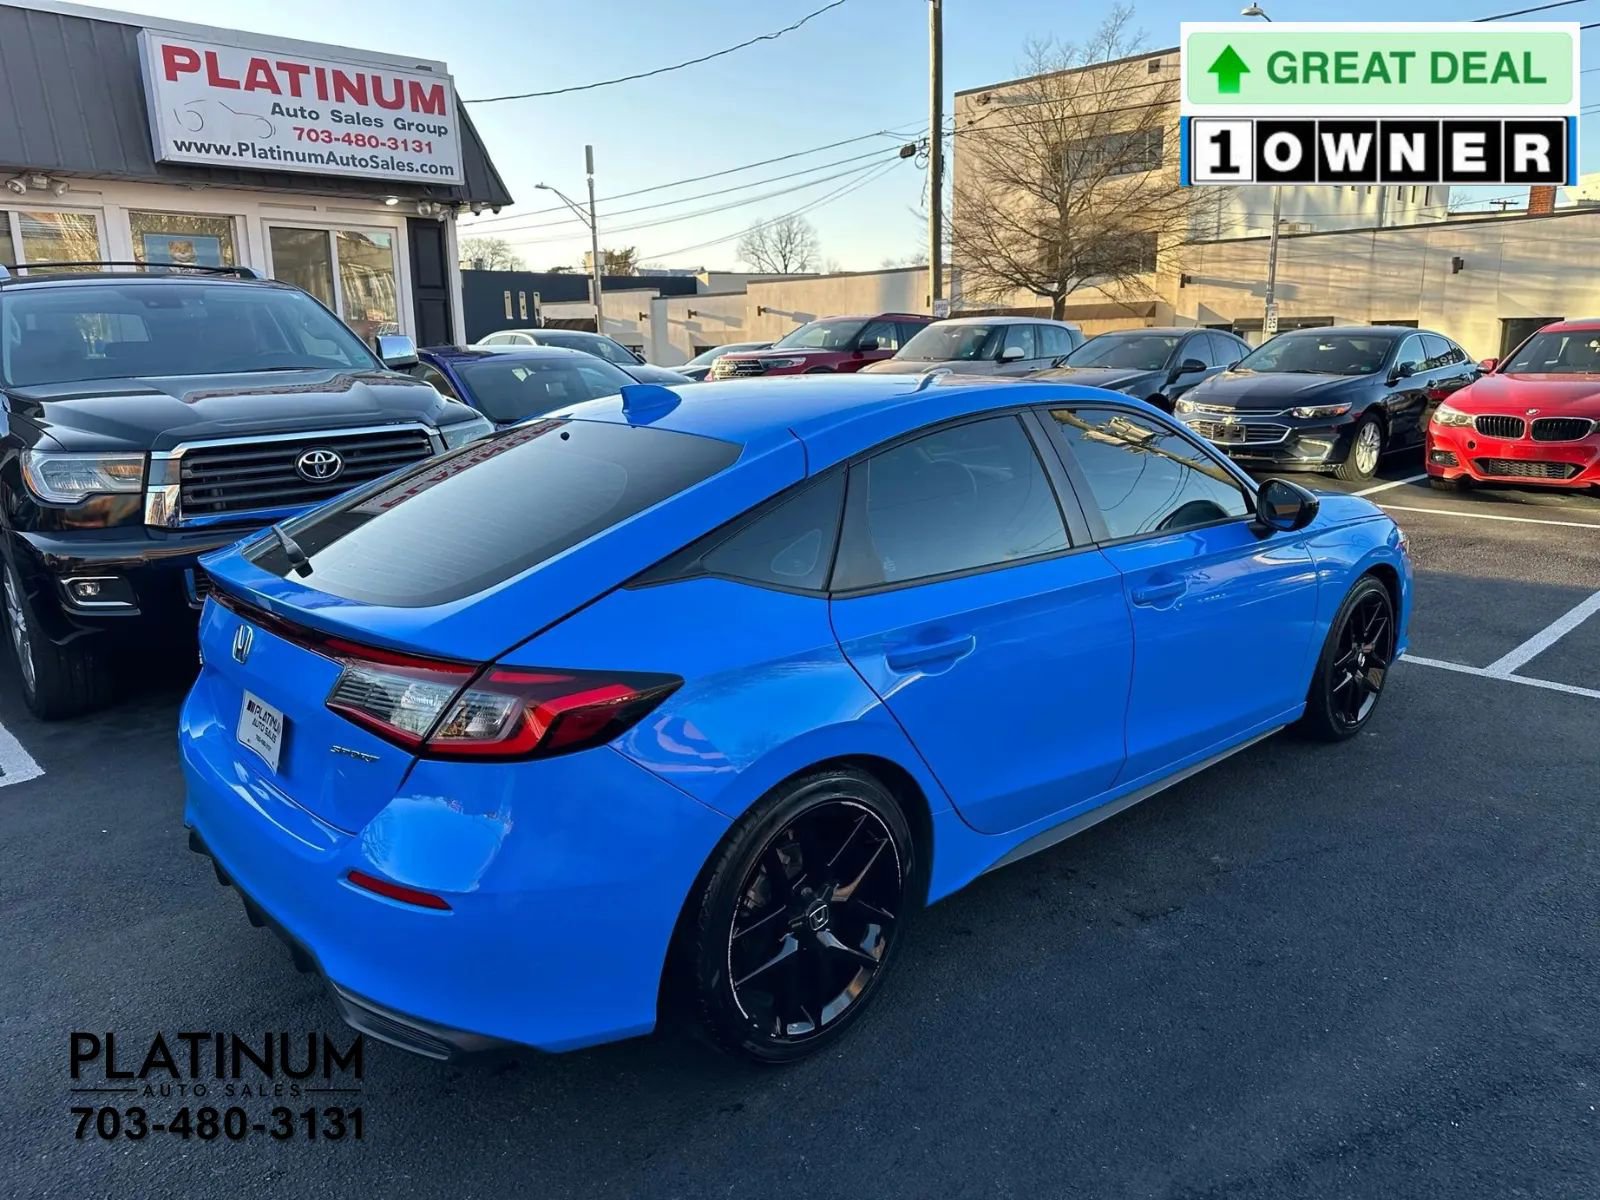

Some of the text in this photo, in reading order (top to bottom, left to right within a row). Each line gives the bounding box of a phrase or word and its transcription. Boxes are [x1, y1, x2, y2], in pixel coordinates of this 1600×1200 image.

[161, 44, 447, 116] PLATINUM
[270, 102, 448, 137] Auto Sales Group
[173, 139, 454, 177] www.PlatinumAutoSales.com
[292, 126, 433, 154] 703-480-3131
